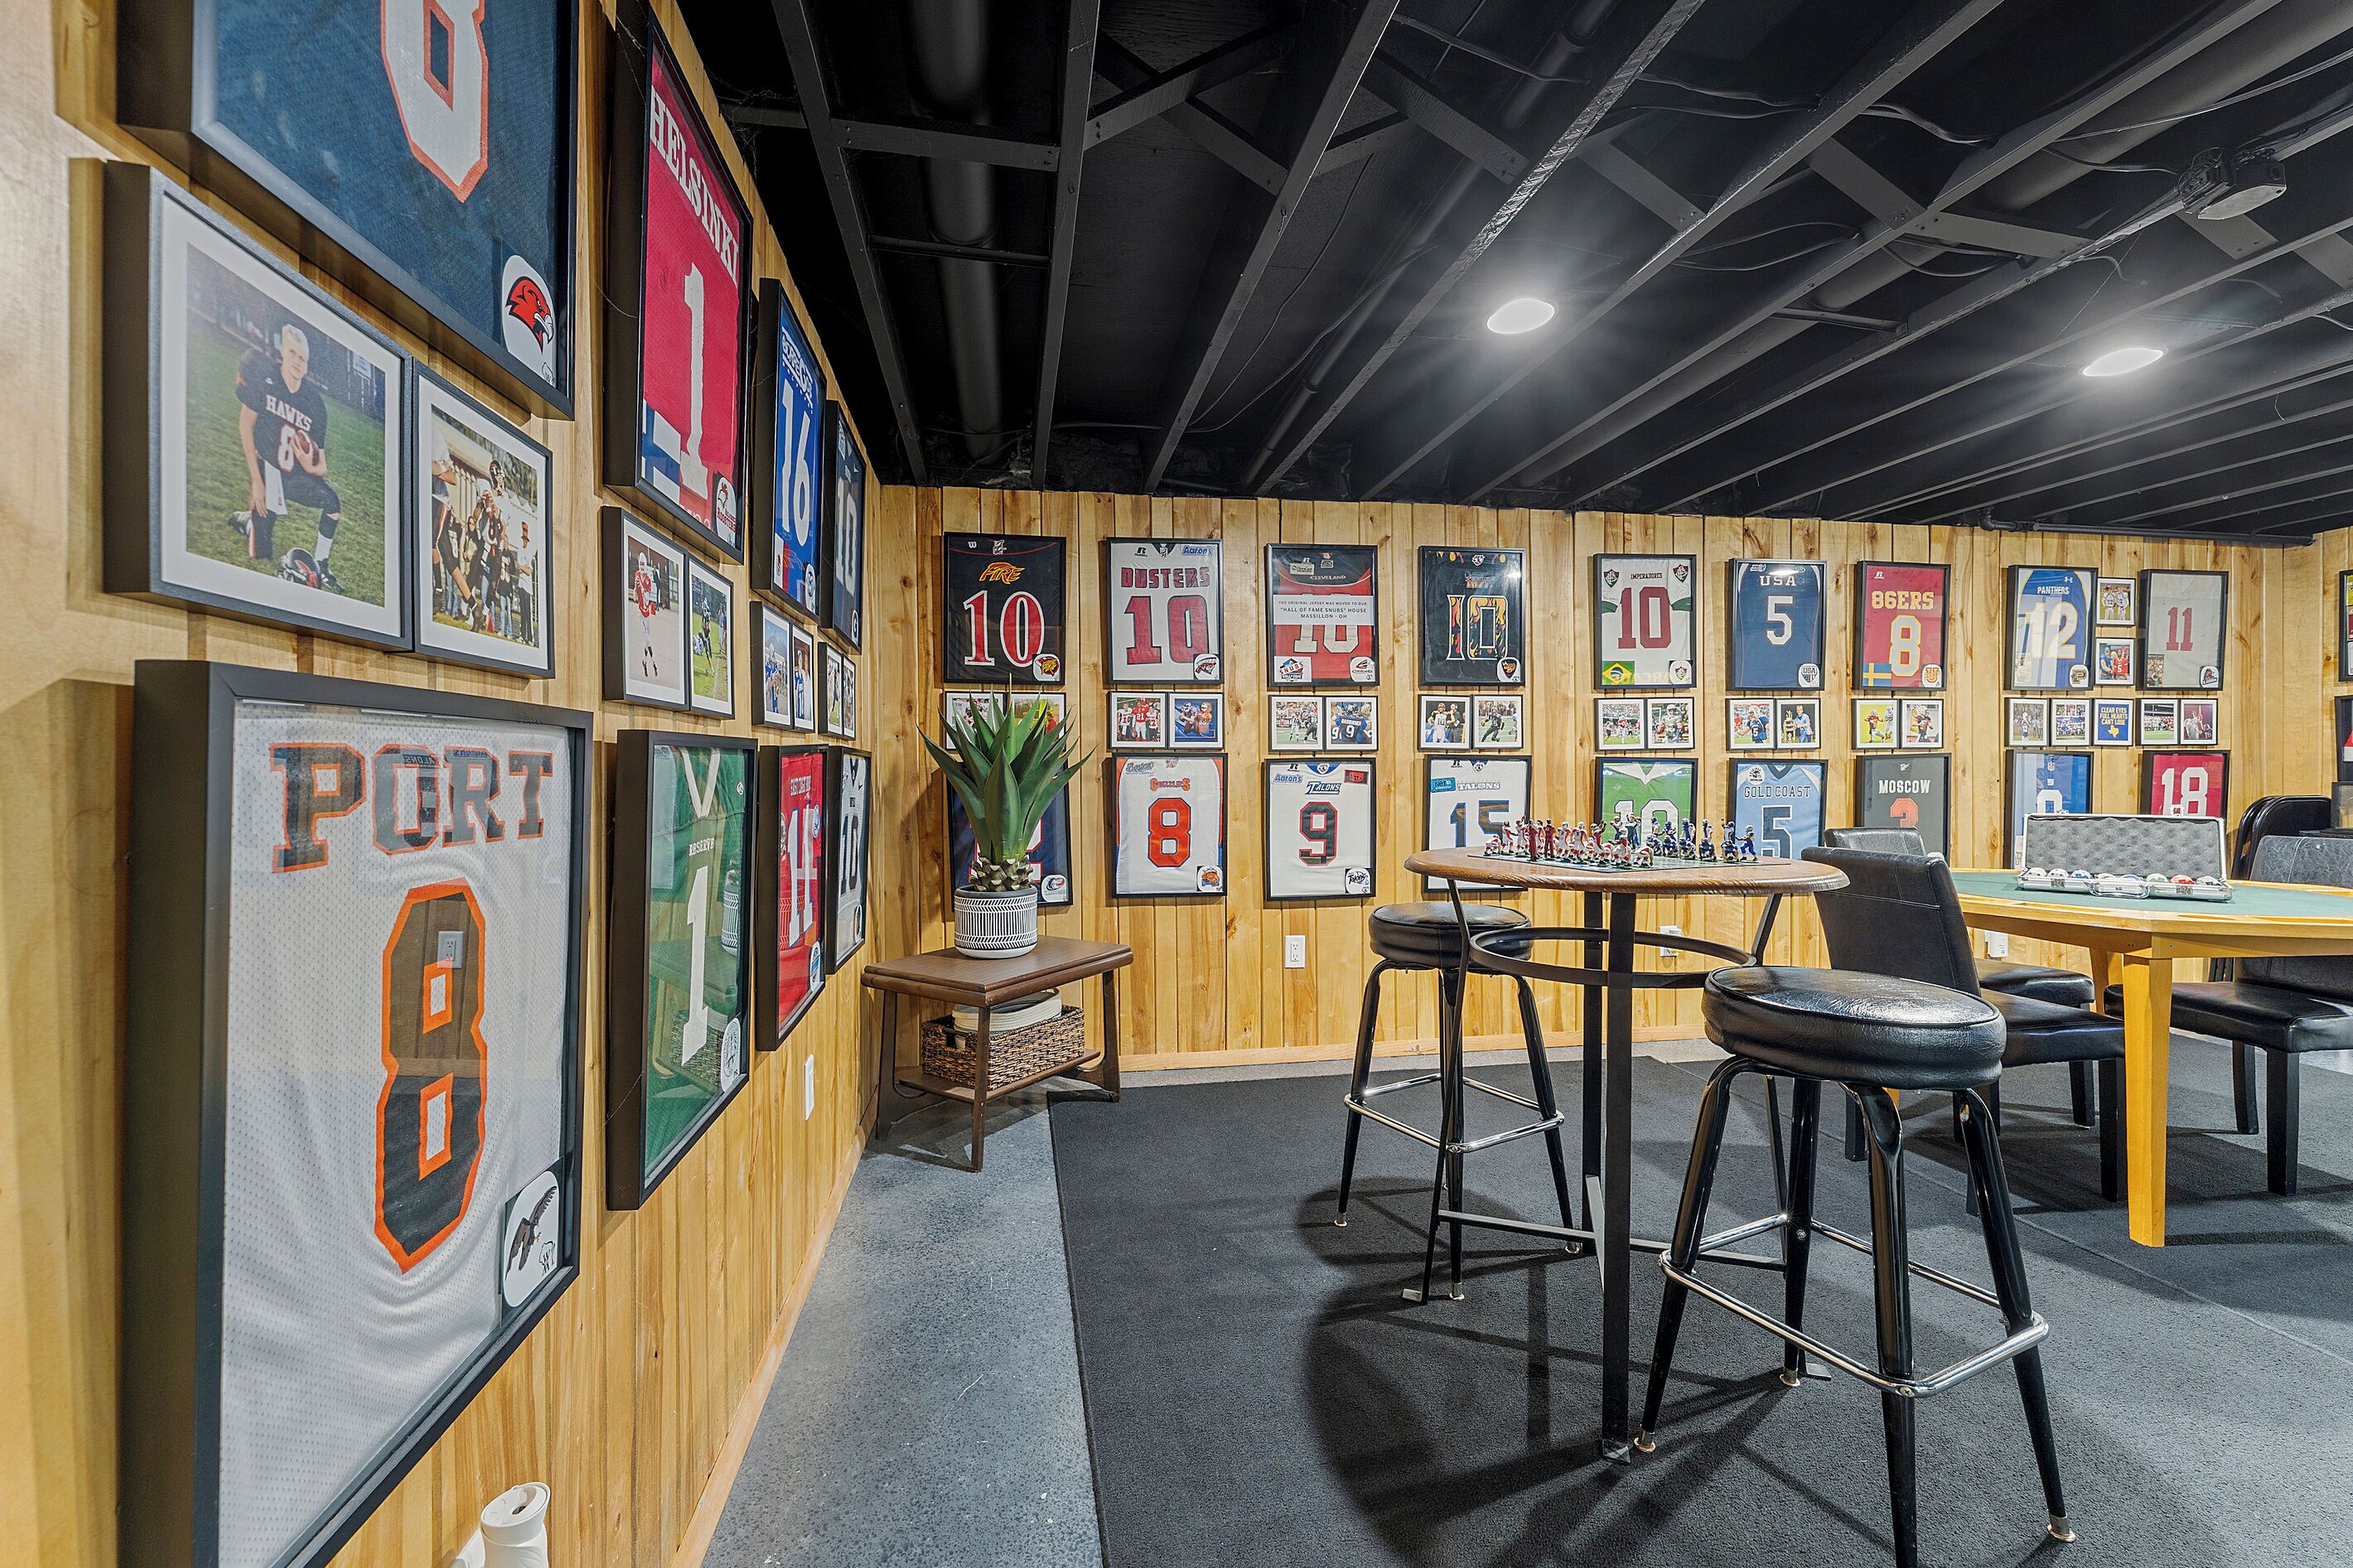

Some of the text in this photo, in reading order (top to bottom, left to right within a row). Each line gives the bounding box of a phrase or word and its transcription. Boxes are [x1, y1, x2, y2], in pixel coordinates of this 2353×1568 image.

[650, 84, 740, 280] HELSINKI
[684, 263, 709, 500] 1
[265, 394, 312, 432] HAWKS
[777, 379, 810, 547] 16
[836, 476, 857, 597] 10
[1182, 545, 1212, 555] Aaron's
[979, 562, 1026, 585] FIRE
[1121, 567, 1210, 589] DUSTERS
[1760, 575, 1796, 586] USA
[2037, 586, 2070, 595] PANTHERS
[1618, 586, 1672, 649] 10
[1766, 595, 1794, 645] 5
[1871, 591, 1935, 610] 86ERS
[963, 589, 1045, 668] 10
[1123, 594, 1210, 665] 10
[1445, 595, 1509, 661] 10
[1889, 615, 1921, 677] 8
[2024, 601, 2078, 659] 12
[2166, 606, 2194, 651] 11
[1278, 661, 1304, 675] SNUBS
[1346, 725, 1355, 738] 9
[1753, 728, 1759, 736] 5
[1150, 777, 1191, 791] GRIZZLIES
[1275, 774, 1302, 784] Aaron's
[1306, 781, 1341, 794] TALONS
[1458, 782, 1500, 791] TALONS
[1744, 785, 1810, 798] GOLD COAST
[1878, 779, 1931, 795] MOSCOW
[2162, 766, 2209, 816] 18
[268, 742, 553, 874] PORT
[1148, 797, 1191, 868] 8
[1761, 804, 1793, 860] 5
[689, 837, 715, 856] RESERVE
[839, 815, 859, 895] 10
[1298, 801, 1338, 867] 9
[681, 866, 708, 1068] 1
[374, 876, 487, 1275] 8
